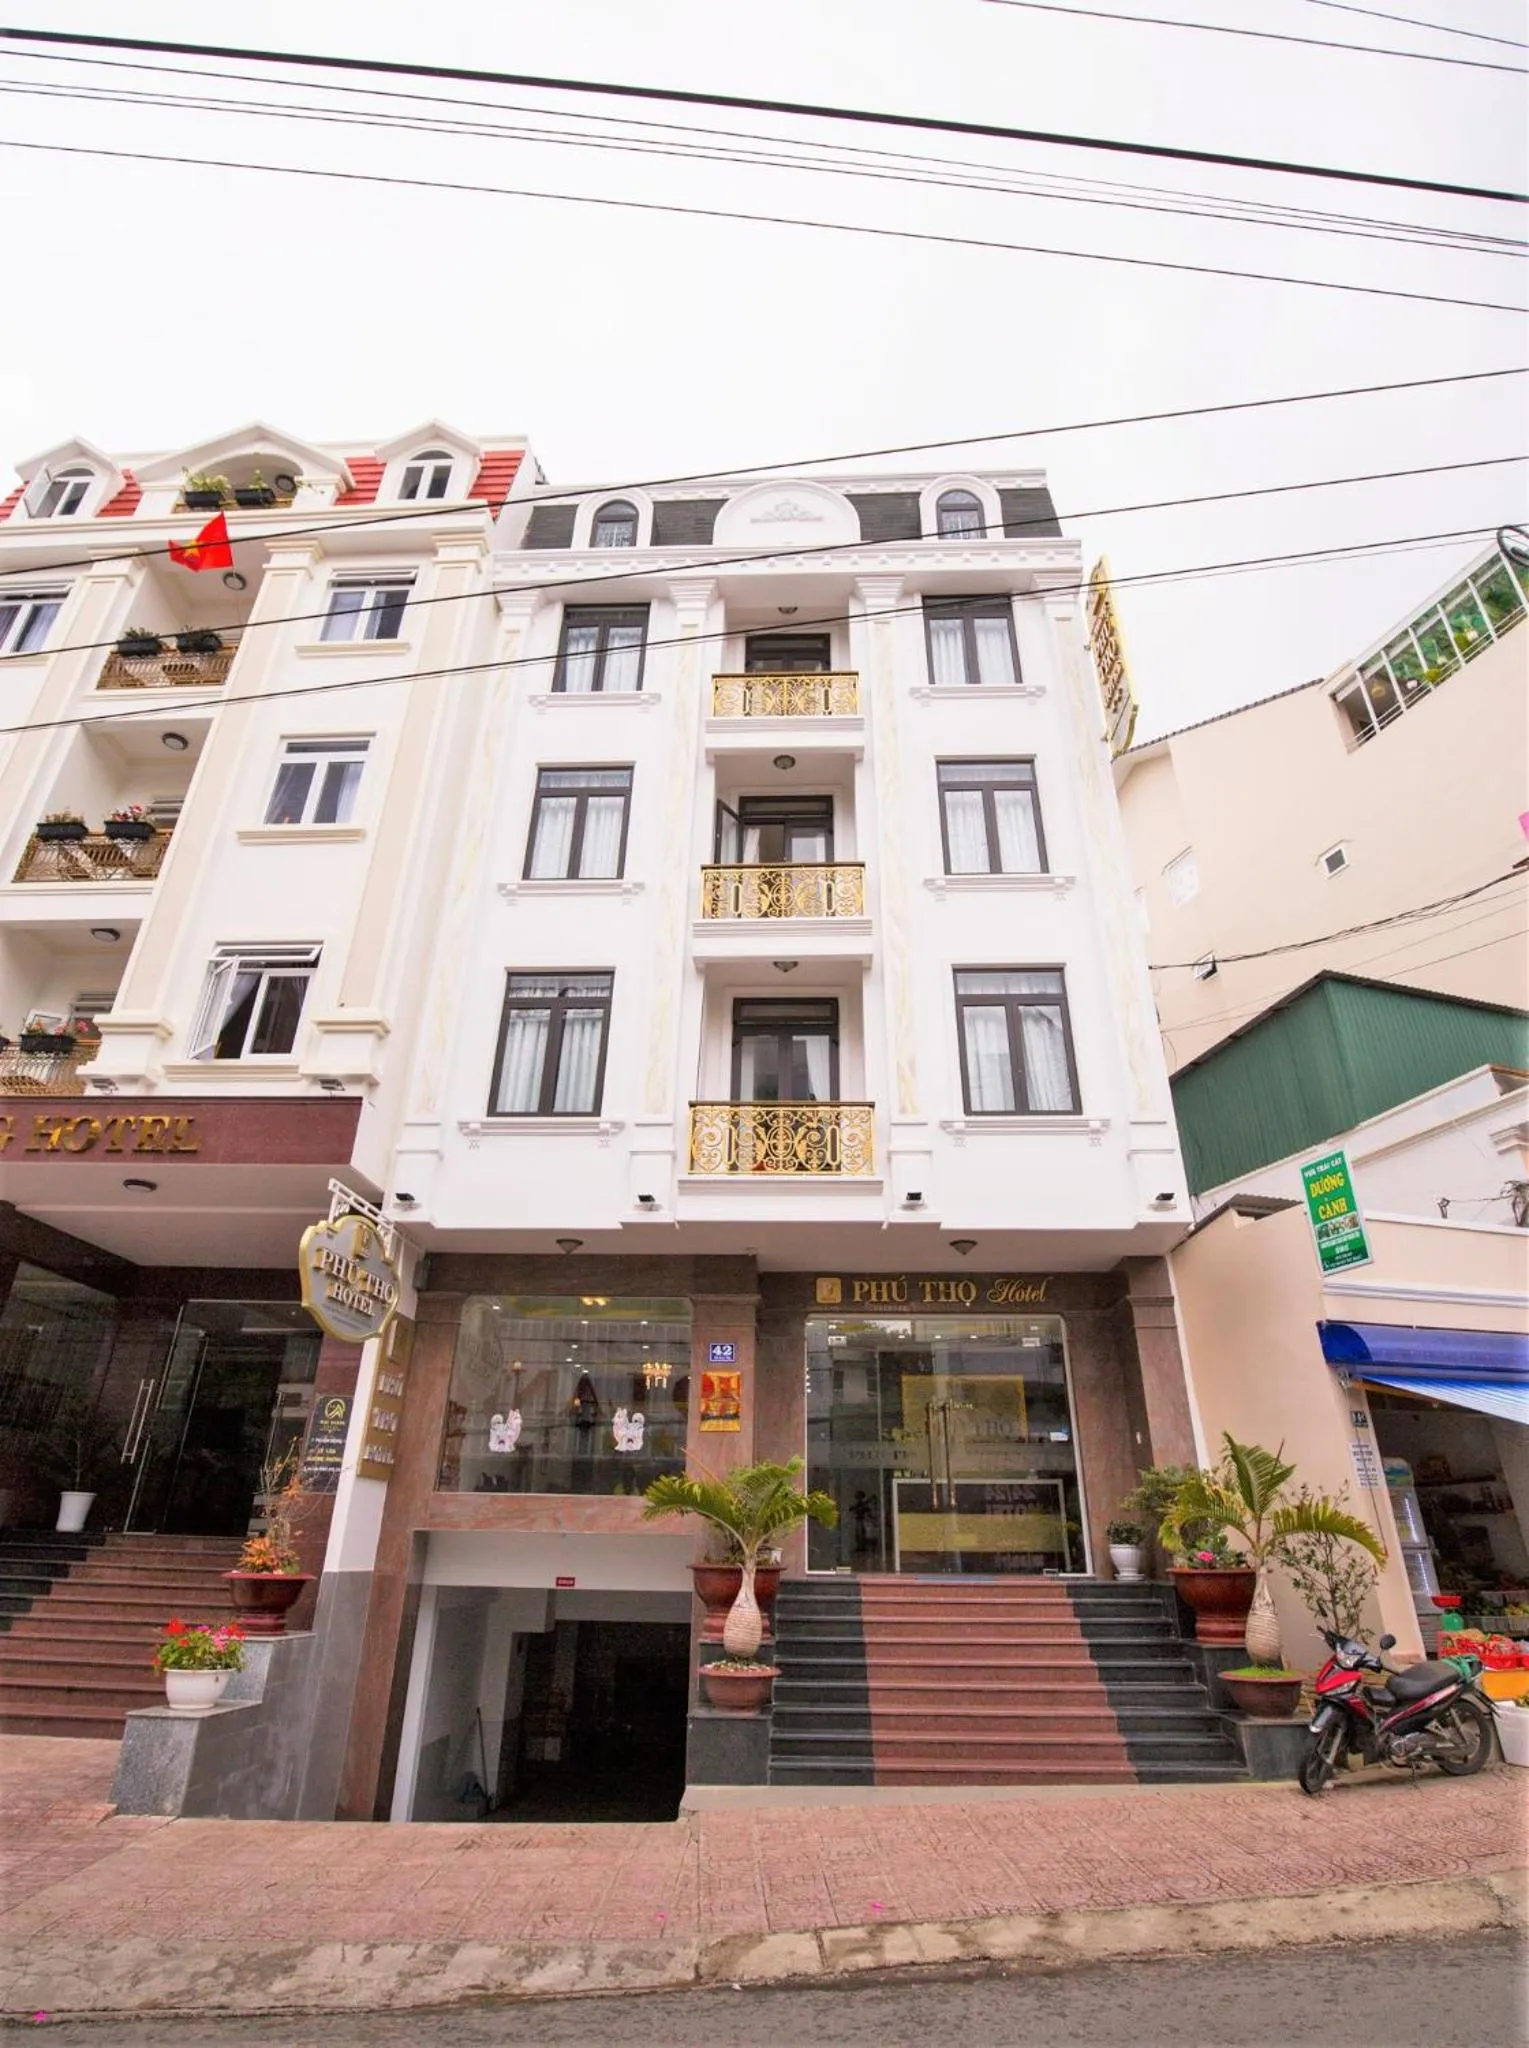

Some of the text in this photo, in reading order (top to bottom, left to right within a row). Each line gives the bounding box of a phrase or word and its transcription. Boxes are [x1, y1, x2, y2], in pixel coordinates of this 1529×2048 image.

[25, 1115, 202, 1153] HOTEL
[331, 1282, 375, 1316] HOTEL
[852, 1275, 1053, 1307] PHÚ THỌ Hotel
[712, 1345, 732, 1356] 42
